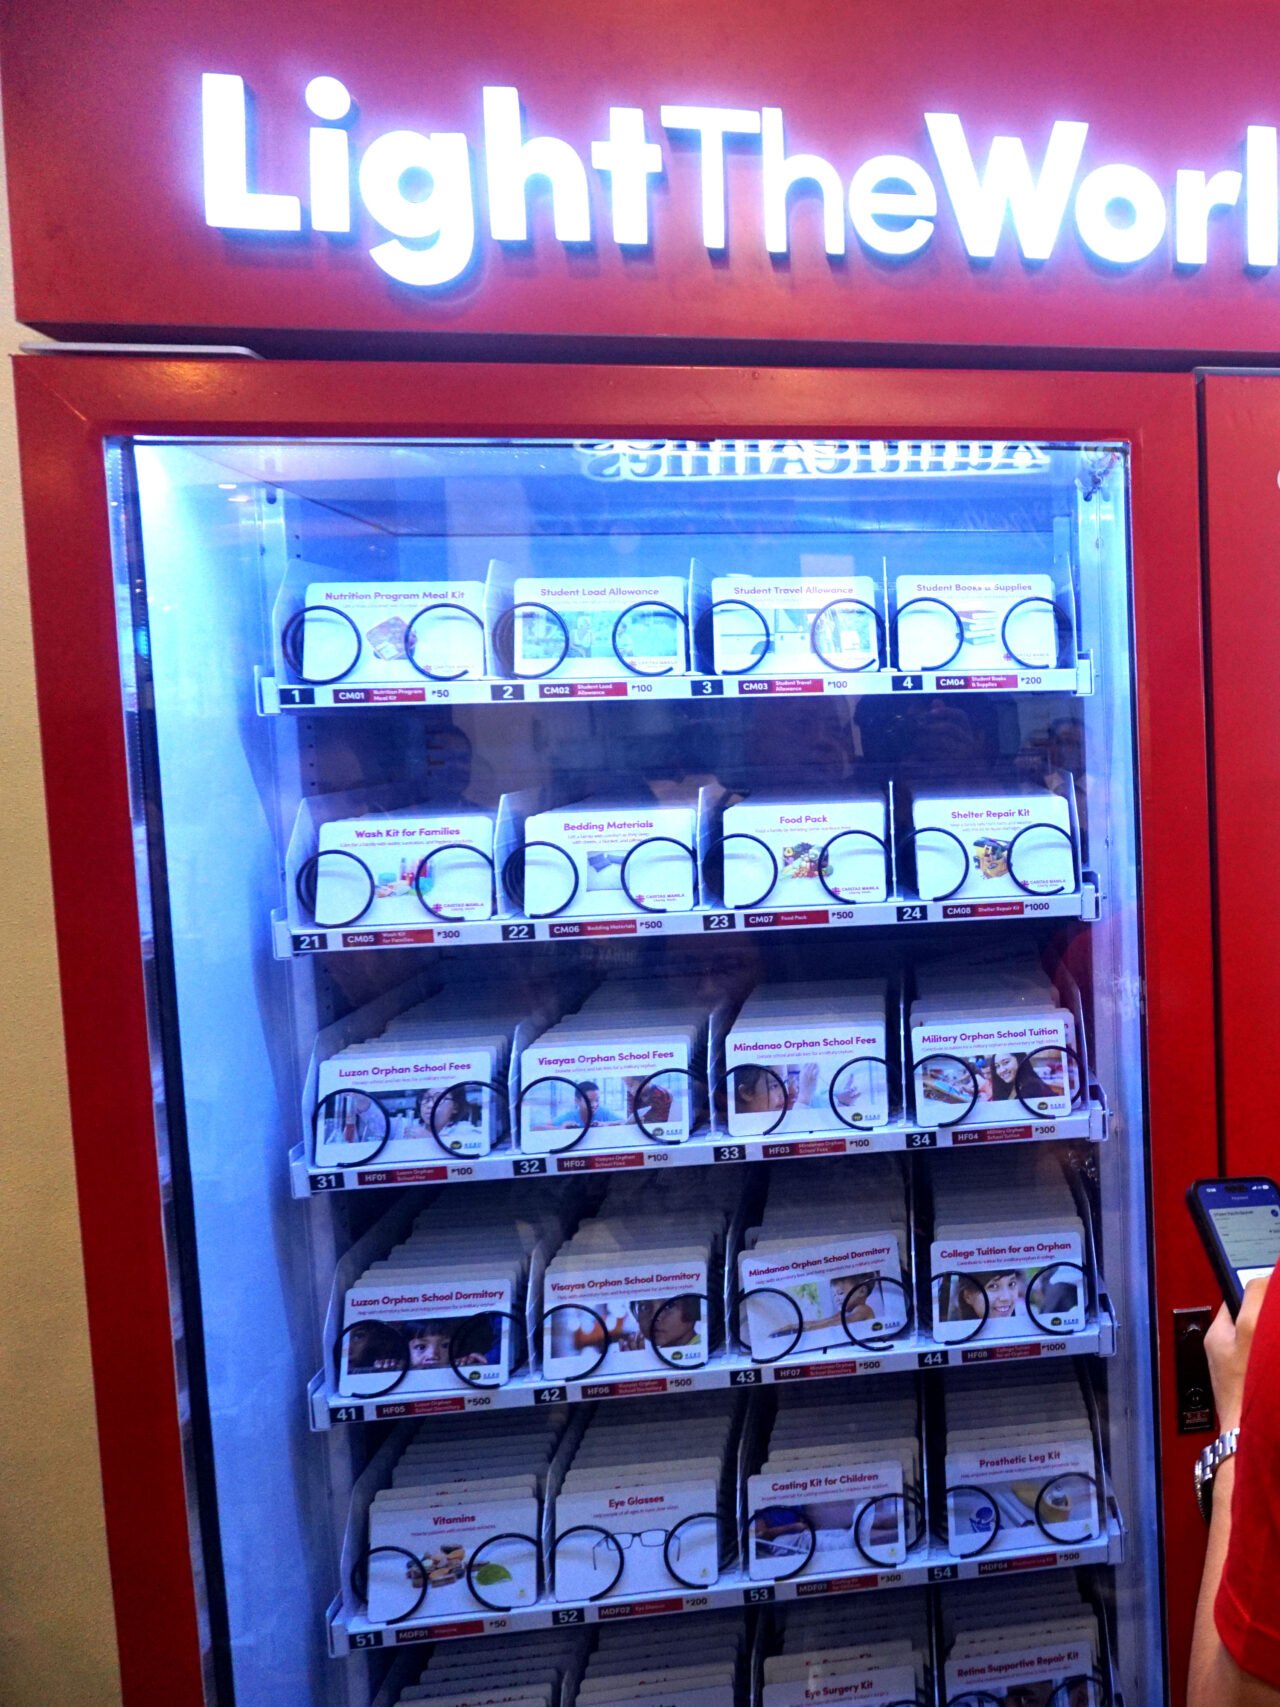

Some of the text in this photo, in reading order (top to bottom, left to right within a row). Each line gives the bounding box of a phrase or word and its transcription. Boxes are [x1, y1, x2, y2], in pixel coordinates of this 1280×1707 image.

[374, 592, 419, 601] Program
[702, 682, 712, 693] 3
[902, 677, 913, 689] 4
[292, 689, 299, 702] 1
[503, 686, 513, 699] 2
[951, 811, 983, 819] Shelter
[986, 810, 1015, 818] Repair
[564, 821, 653, 831] Bedding Materials
[355, 830, 383, 838] Wash
[419, 828, 460, 836] Families
[902, 907, 921, 920] 24
[709, 915, 729, 928] 23
[508, 926, 528, 938] 22
[299, 936, 321, 949] 21
[922, 1035, 957, 1044] Military
[960, 1033, 994, 1042] Orphan
[997, 1030, 1026, 1039] School
[1029, 1028, 1058, 1036] Tuition
[734, 1043, 782, 1051] Mindanao
[784, 1040, 820, 1049] Orphan
[823, 1037, 853, 1046] School
[538, 1058, 575, 1067] Visayas
[578, 1055, 615, 1064] Orphan
[618, 1052, 650, 1060] School
[339, 1069, 369, 1077] Luzon
[372, 1066, 410, 1076] Orphan
[413, 1064, 446, 1072] School
[912, 1134, 930, 1146] 34
[720, 1147, 739, 1160] 33
[520, 1161, 540, 1174] 32
[317, 1175, 336, 1188] 31
[940, 1250, 974, 1259] College
[976, 1248, 1006, 1256] Tuition
[1037, 1243, 1071, 1252] Orphan
[749, 1265, 789, 1276] Mindanao
[792, 1259, 822, 1270] Orphan
[824, 1253, 849, 1263] School
[851, 1247, 890, 1258] Dormitory
[551, 1283, 585, 1292] Visayas
[588, 1279, 622, 1289] Orphan
[625, 1276, 654, 1285] School
[656, 1273, 700, 1283] Dormitory
[382, 1296, 418, 1305] Orphan
[421, 1293, 453, 1302] School
[455, 1290, 504, 1301] Dormitory
[924, 1352, 943, 1365] 44
[736, 1371, 755, 1383] 43
[540, 1389, 560, 1401] 42
[337, 1408, 356, 1420] 41
[979, 1456, 1026, 1467] Prosthetic
[1029, 1454, 1045, 1463] Leg
[772, 1480, 807, 1492] Casting
[810, 1478, 821, 1487] Kit
[825, 1477, 836, 1485] for
[840, 1473, 878, 1483] Children
[609, 1495, 664, 1508] Eye Glasses
[433, 1514, 475, 1525] Vitamins
[934, 1567, 952, 1578] 54
[750, 1589, 768, 1602] 53
[559, 1610, 578, 1623] 52
[356, 1633, 374, 1646] 51
[957, 1652, 1079, 1677] Retina Supportive Repair Kit
[805, 1681, 872, 1698] Eye Surgery Kit
